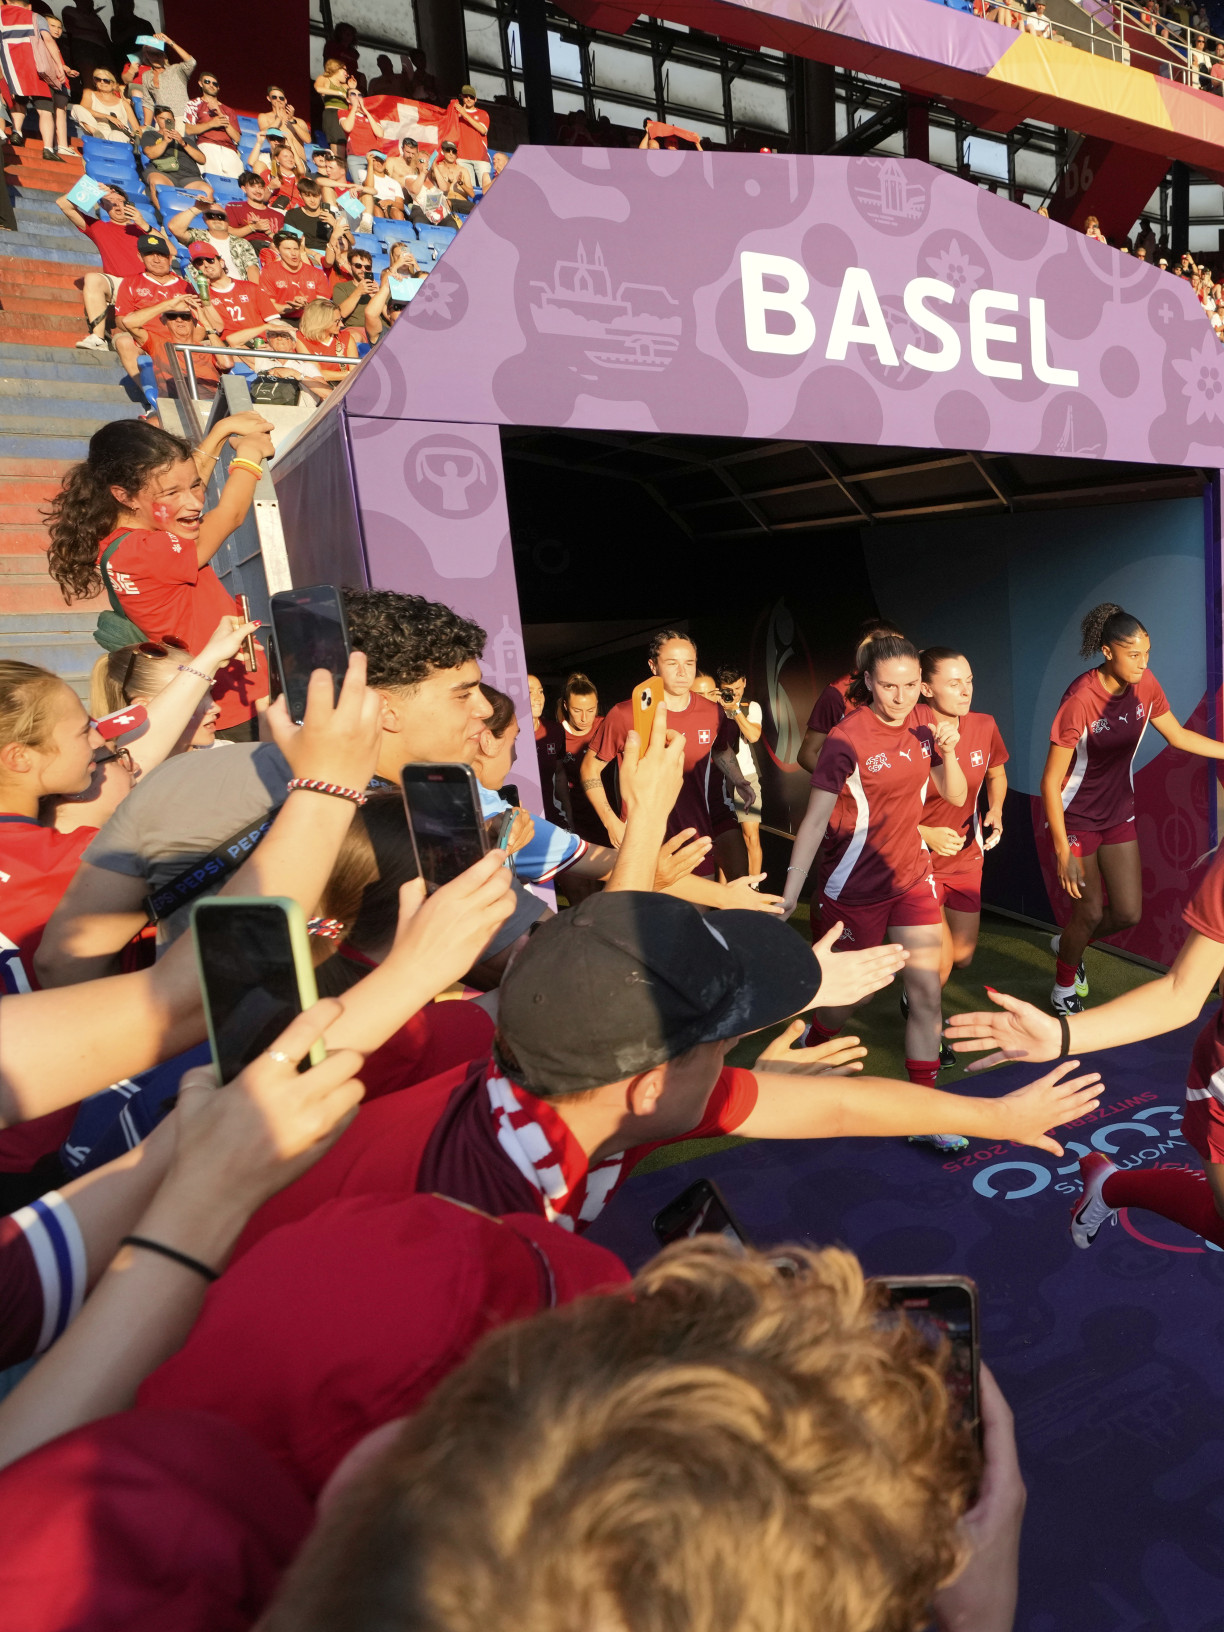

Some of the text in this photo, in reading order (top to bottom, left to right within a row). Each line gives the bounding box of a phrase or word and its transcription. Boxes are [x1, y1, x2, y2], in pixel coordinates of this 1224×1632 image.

[226, 306, 245, 322] 22
[740, 250, 1079, 387] BASEL
[176, 856, 226, 895] PEPSI
[227, 818, 275, 860] PEPS
[941, 1144, 1009, 1173] 2025
[1054, 1139, 1188, 1195] wom's
